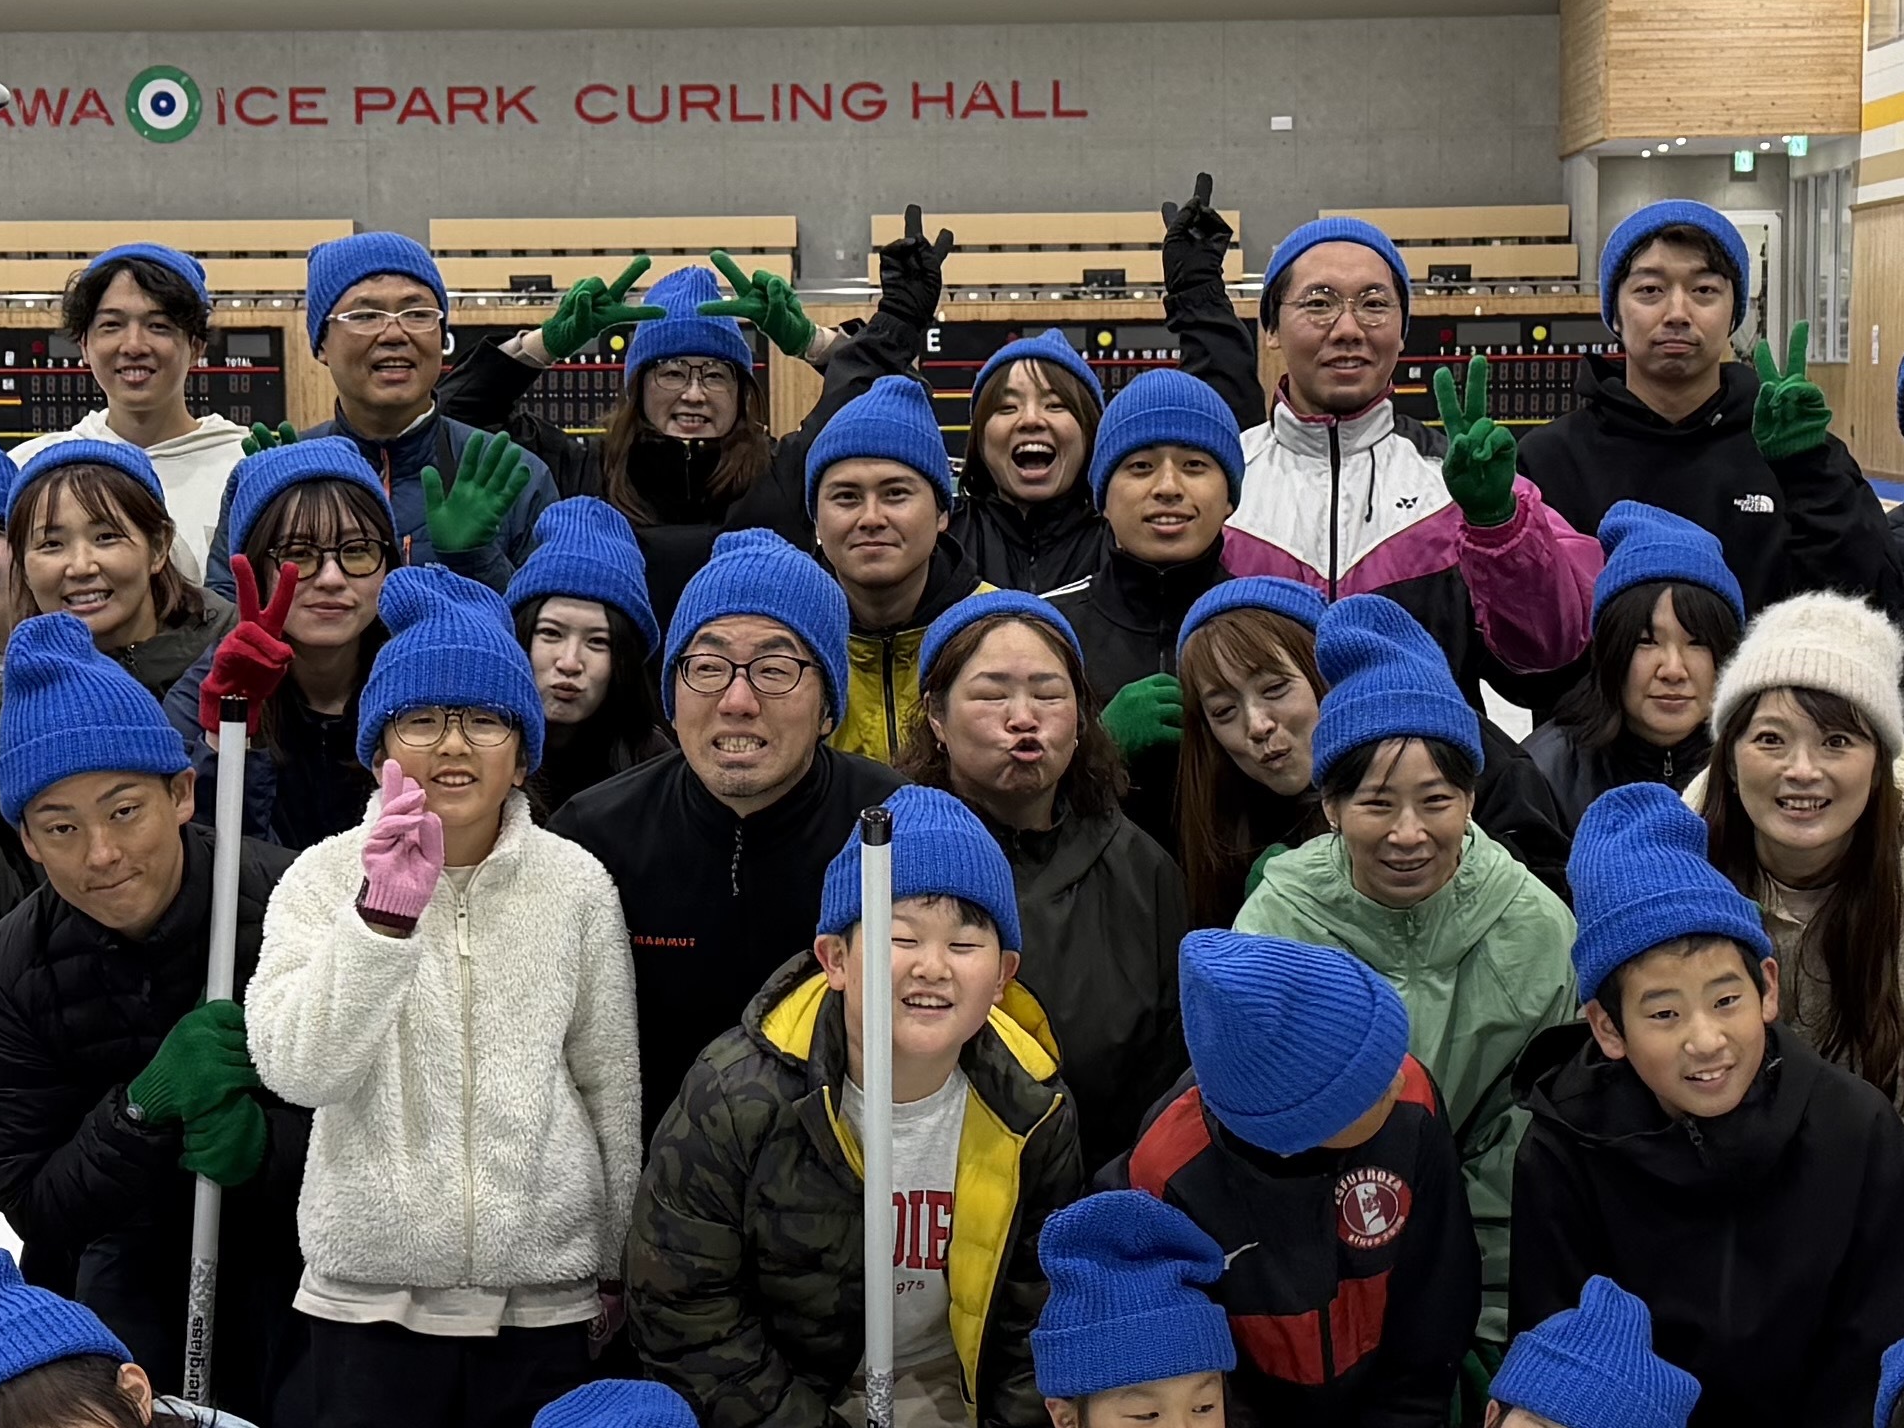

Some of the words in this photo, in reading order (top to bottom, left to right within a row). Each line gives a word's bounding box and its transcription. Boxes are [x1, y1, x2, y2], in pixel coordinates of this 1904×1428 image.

[217, 87, 326, 126] ICE
[355, 86, 538, 124] PARK
[575, 82, 888, 125] CURLING
[912, 80, 1088, 119] HALL
[926, 328, 941, 352] E
[225, 357, 252, 368] TOTAL
[634, 935, 696, 948] MAMMUT
